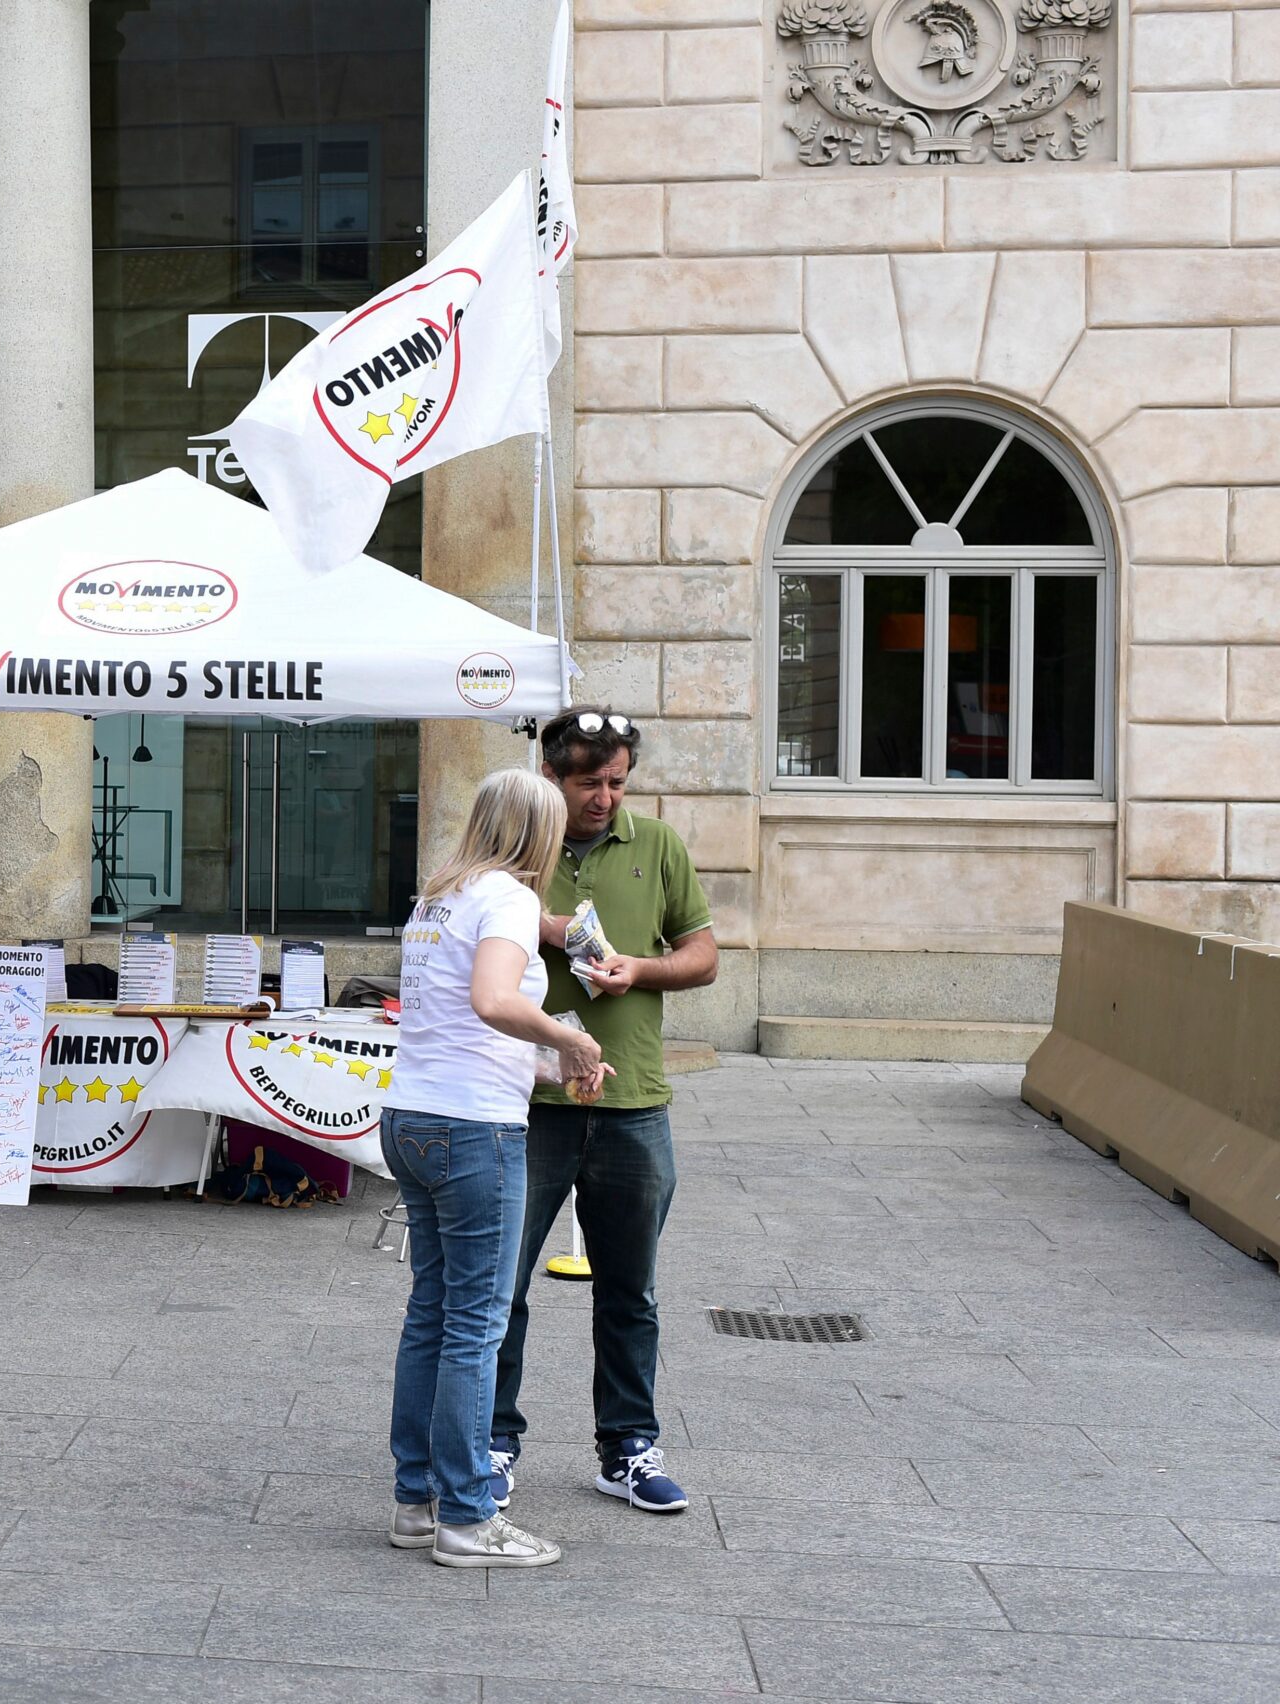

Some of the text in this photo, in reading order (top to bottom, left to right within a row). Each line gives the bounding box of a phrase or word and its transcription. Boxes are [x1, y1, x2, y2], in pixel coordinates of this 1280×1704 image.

[74, 580, 226, 598] MOVIMENTO
[166, 660, 188, 699] 5
[203, 660, 323, 701] STELLE
[461, 666, 511, 679] MOVIMENTO
[249, 1065, 371, 1128] BEPPEGRILLO.IT
